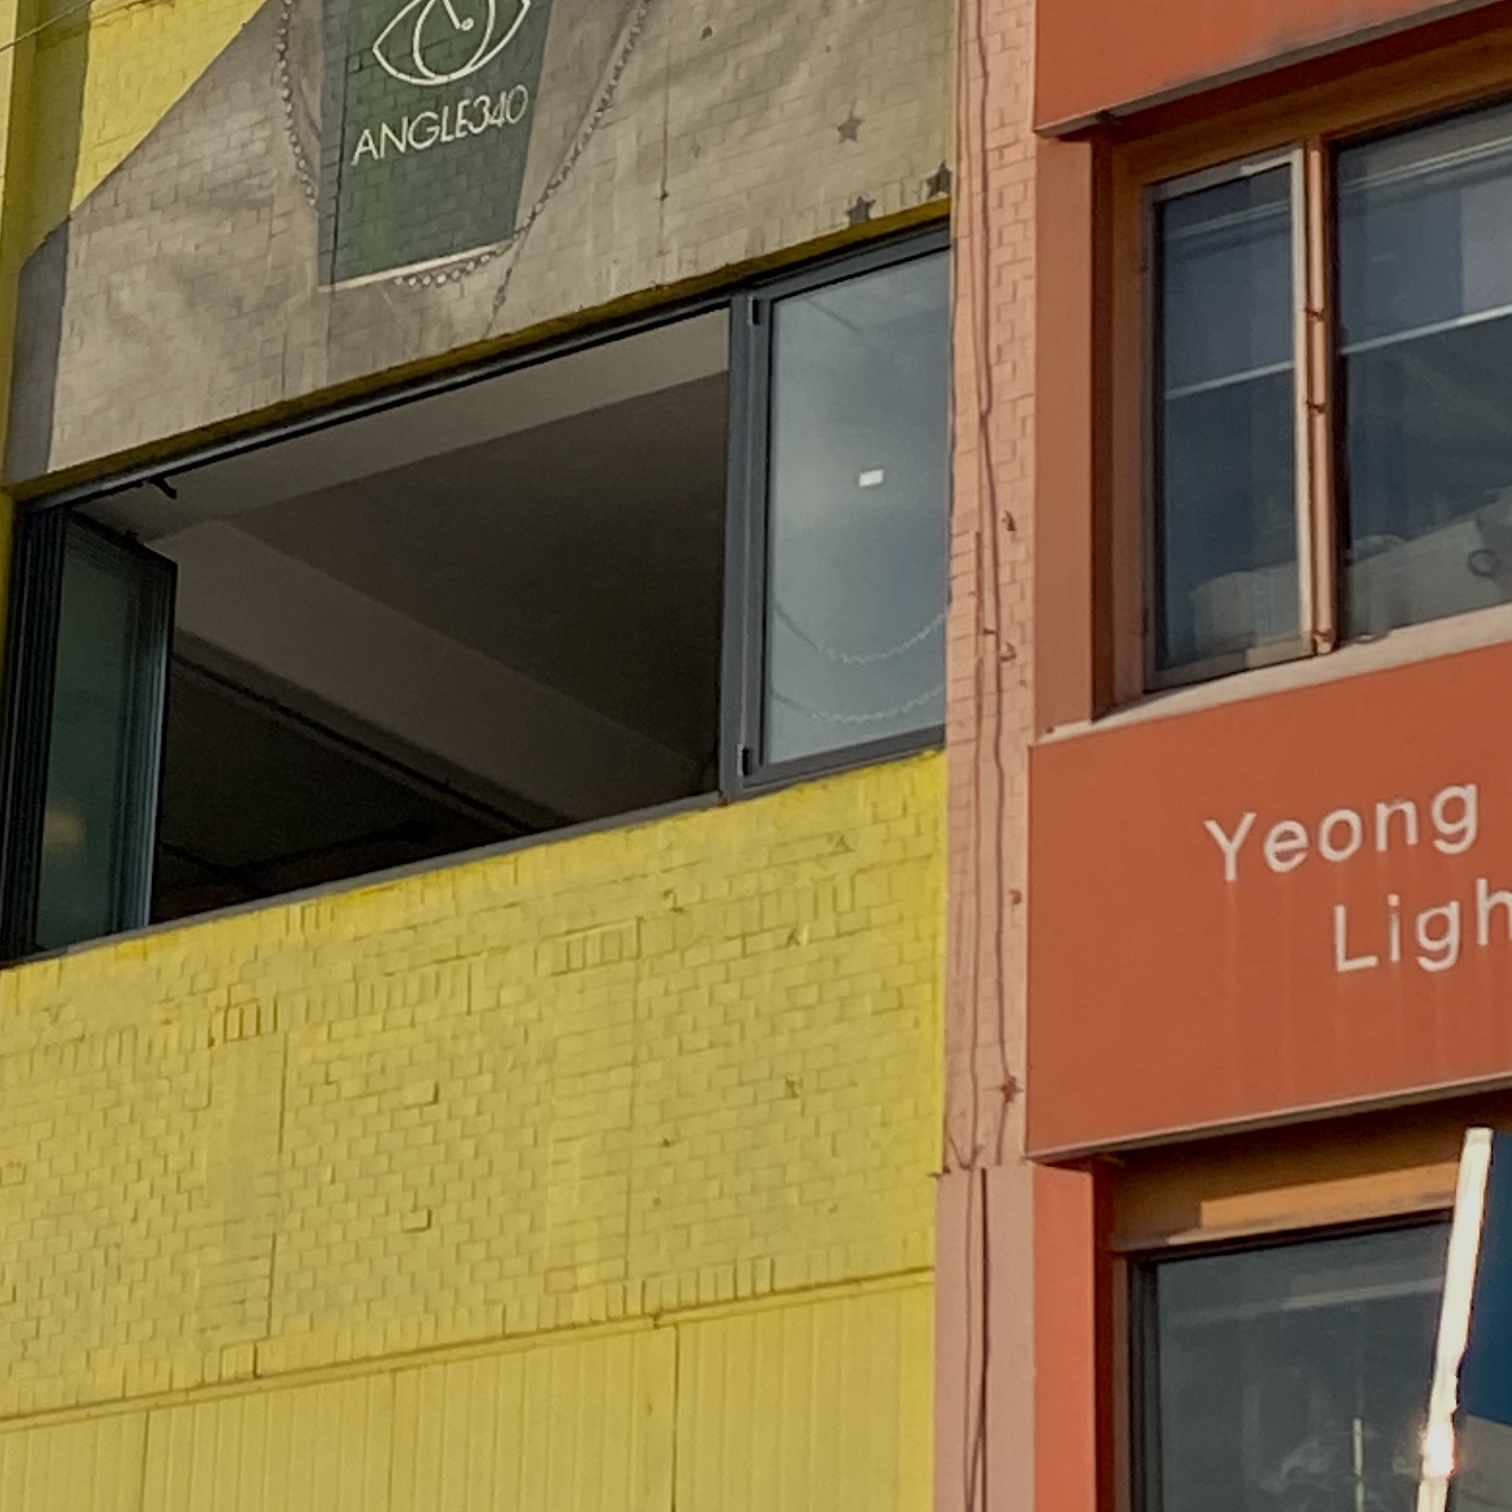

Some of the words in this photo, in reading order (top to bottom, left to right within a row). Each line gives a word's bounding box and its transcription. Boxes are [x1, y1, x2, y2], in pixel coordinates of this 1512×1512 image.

[351, 84, 529, 166] ANGLE340
[1204, 783, 1478, 883] Yeong
[1334, 877, 1512, 972] Ligh
